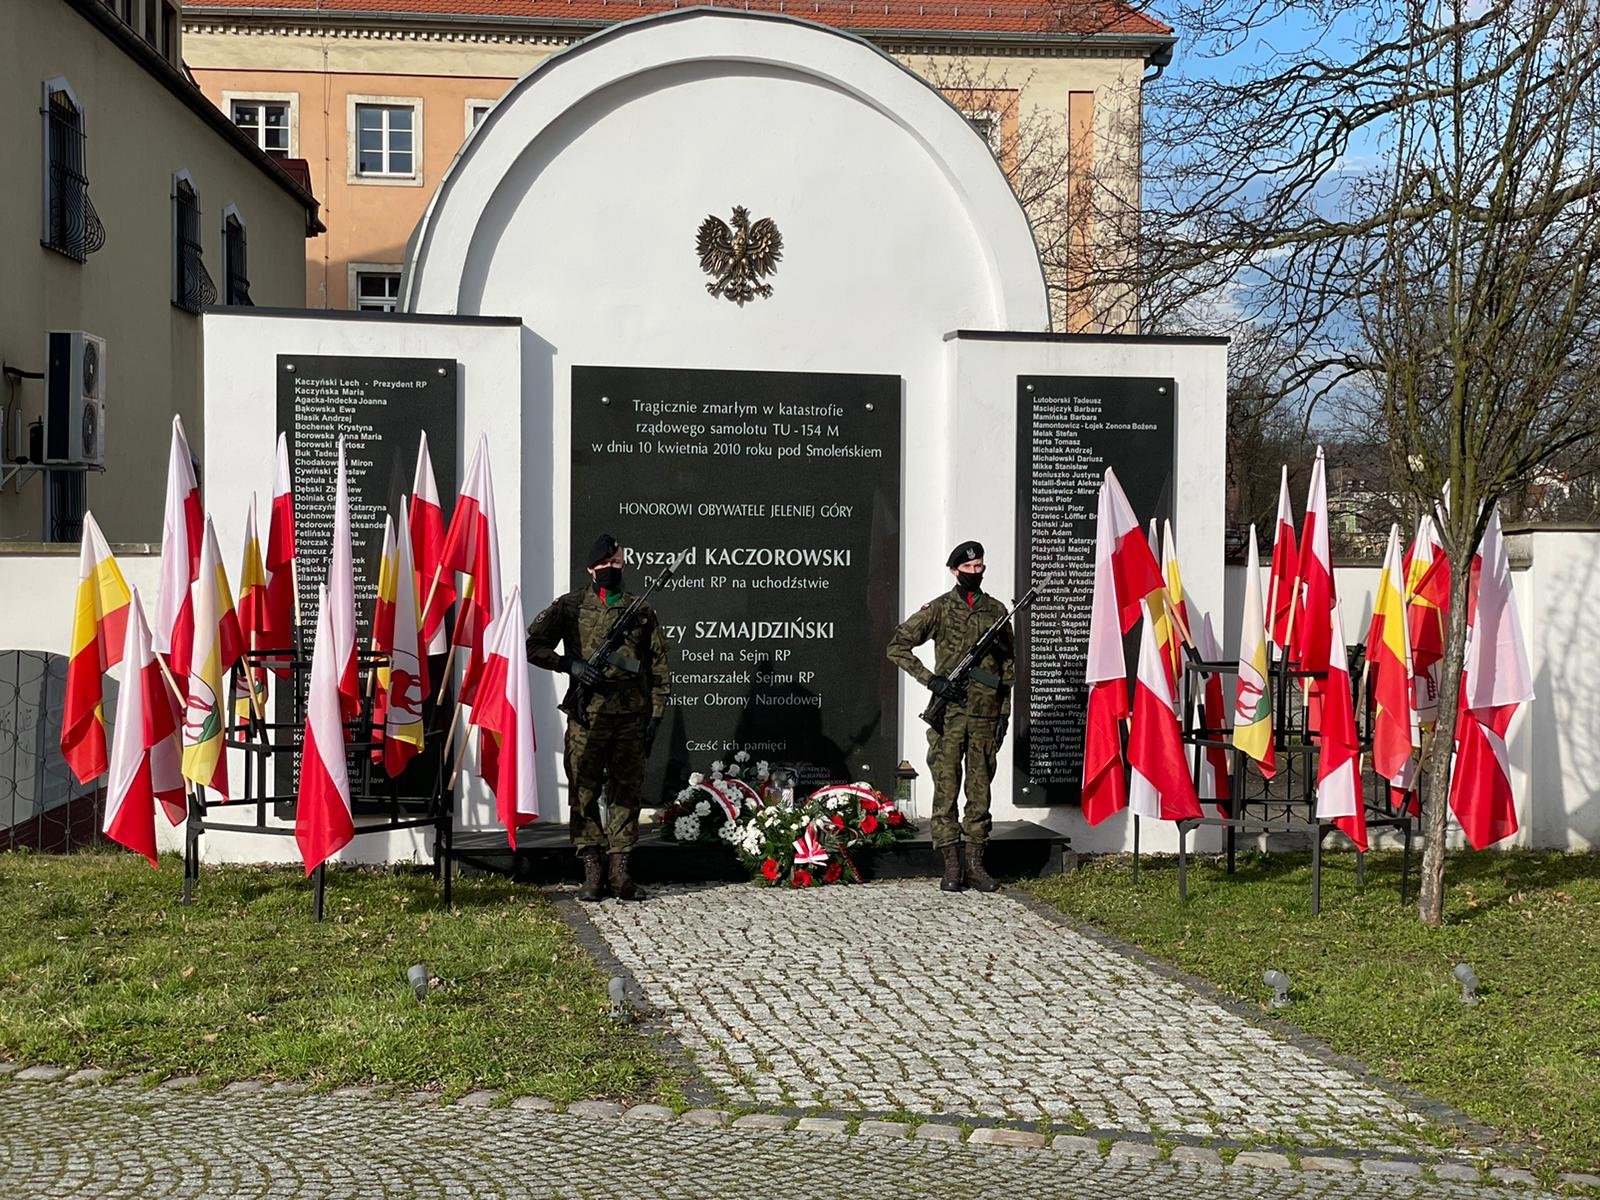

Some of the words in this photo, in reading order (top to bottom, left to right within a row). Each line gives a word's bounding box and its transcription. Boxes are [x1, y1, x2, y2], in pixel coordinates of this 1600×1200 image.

[295, 378, 337, 387] Kaczyński
[373, 379, 413, 388] Prezydent
[295, 387, 339, 396] Kaczyńska
[633, 400, 697, 416] Tragicznie
[703, 402, 757, 418] zmarłym
[763, 406, 773, 414] w
[779, 402, 843, 416] katastrofie
[322, 414, 352, 423] Andrzej
[338, 424, 373, 432] Krystyna
[636, 422, 705, 436] rządowego
[711, 422, 767, 435] samolotu
[827, 425, 839, 436] M
[592, 444, 602, 452] w
[607, 440, 633, 453] dniu
[638, 442, 652, 453] 10
[658, 442, 708, 455] kwietnia
[714, 443, 740, 455] 2010
[746, 444, 772, 456] roku
[778, 444, 800, 459] pod
[806, 445, 882, 458] Smoleńskiem
[1065, 447, 1092, 455] Andrzej
[1072, 472, 1100, 480] Justyna
[619, 503, 692, 516] HONOROWI
[698, 504, 765, 517] OBYWATELE
[770, 504, 815, 518] JELENIEJ
[820, 502, 853, 518] GÓRY
[624, 547, 696, 570] Ryszad
[706, 548, 851, 566] KACZOROWSKI
[644, 575, 704, 591] Przydent
[711, 576, 727, 588] RP
[732, 580, 746, 588] na
[752, 576, 829, 589] uchodźstwie
[695, 617, 834, 641] SZMAJDZIŃSKI
[682, 649, 714, 661] Poseł
[720, 653, 734, 662] na
[740, 650, 769, 663] Sejm
[775, 650, 791, 662] RP
[670, 671, 750, 684] icemarszałek
[756, 672, 792, 686] Sejmu
[799, 672, 814, 684] RP
[666, 694, 699, 706] nister
[704, 694, 749, 709] Obrony
[756, 694, 822, 708] Narodowej
[686, 740, 718, 751] Cześć
[723, 741, 739, 750] ich
[744, 740, 786, 752] pamięci
